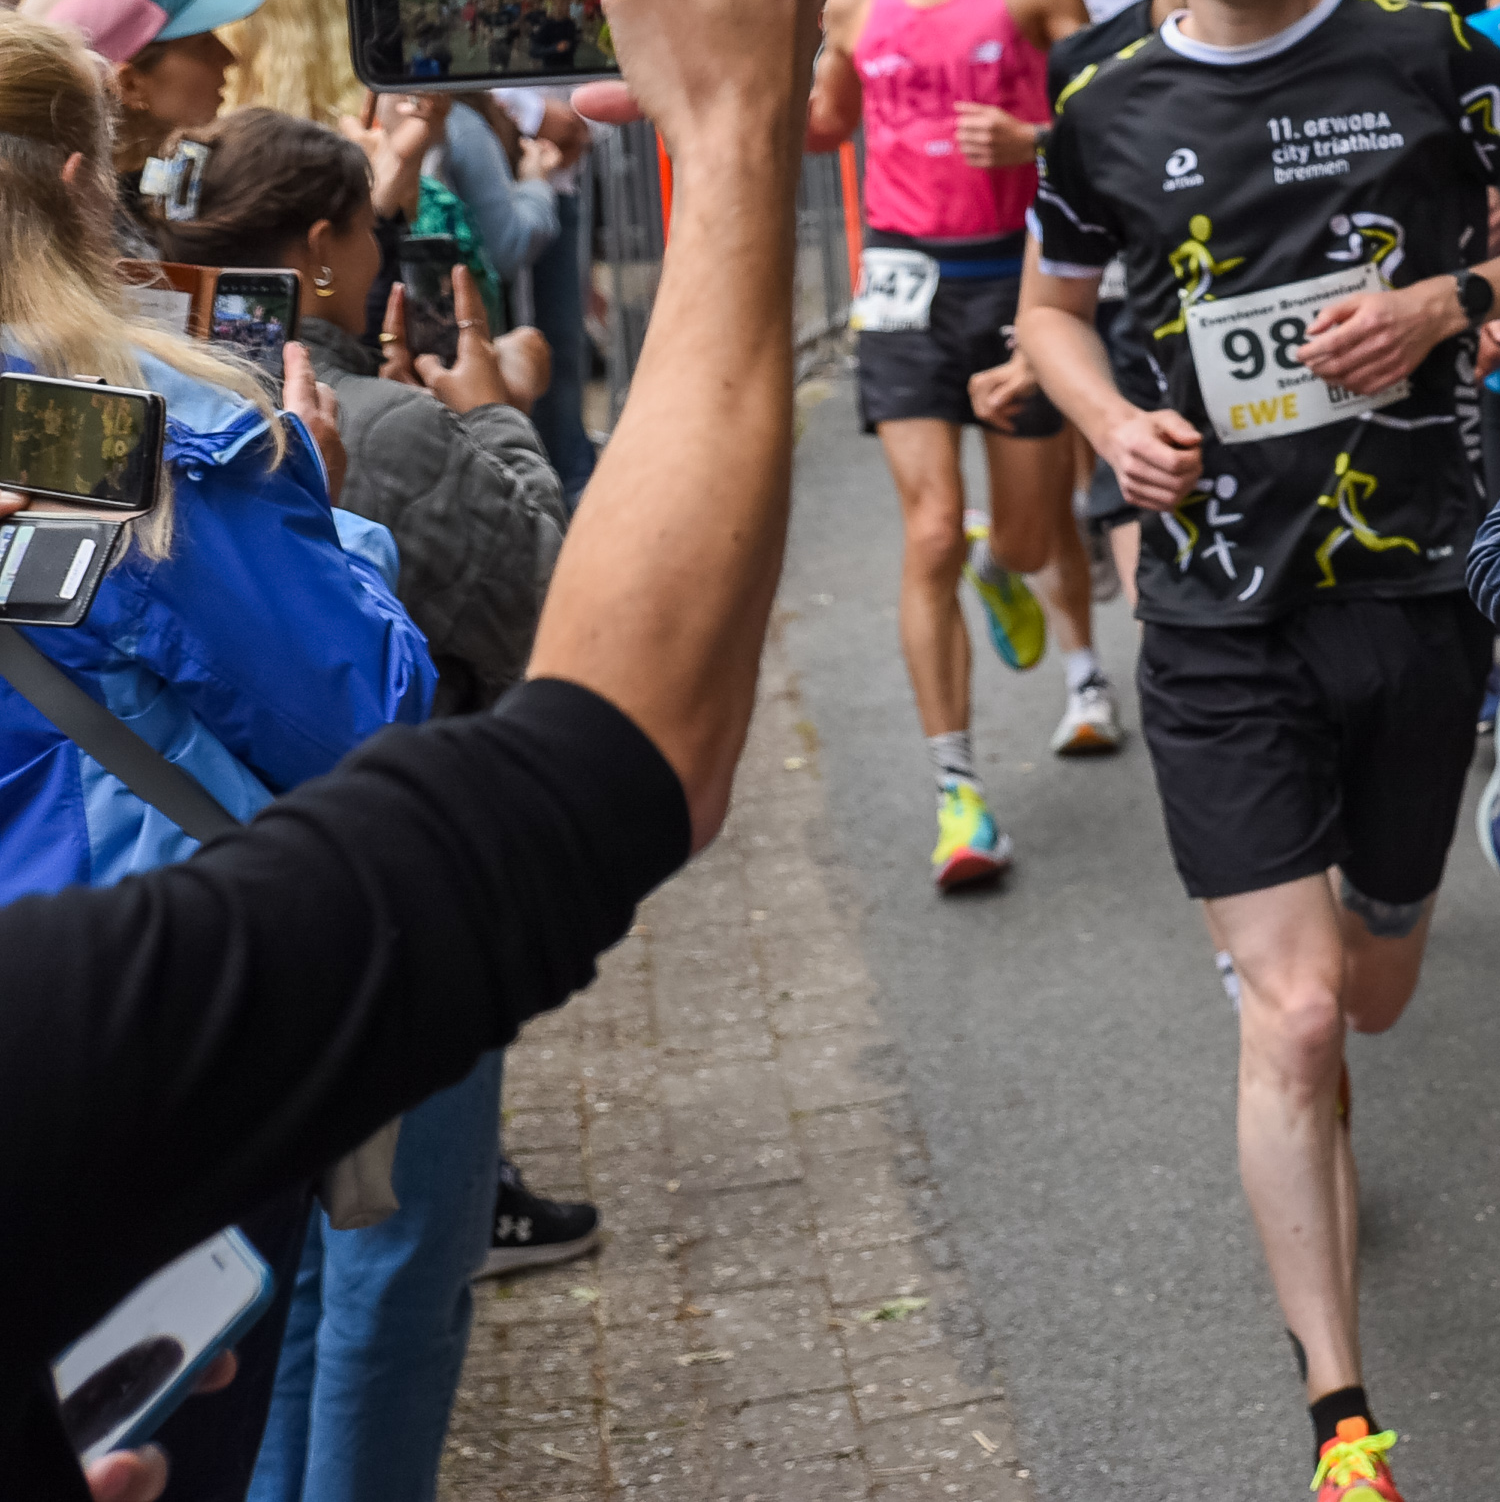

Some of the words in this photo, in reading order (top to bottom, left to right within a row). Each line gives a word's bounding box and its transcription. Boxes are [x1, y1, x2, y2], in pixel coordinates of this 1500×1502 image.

[1267, 116, 1301, 143] 11.
[1303, 111, 1392, 138] GEWOBA
[1272, 144, 1311, 165] city
[1313, 132, 1405, 158] triathlon
[1273, 159, 1350, 185] bremen
[1222, 309, 1322, 381] 98
[1229, 392, 1299, 431] EWE
